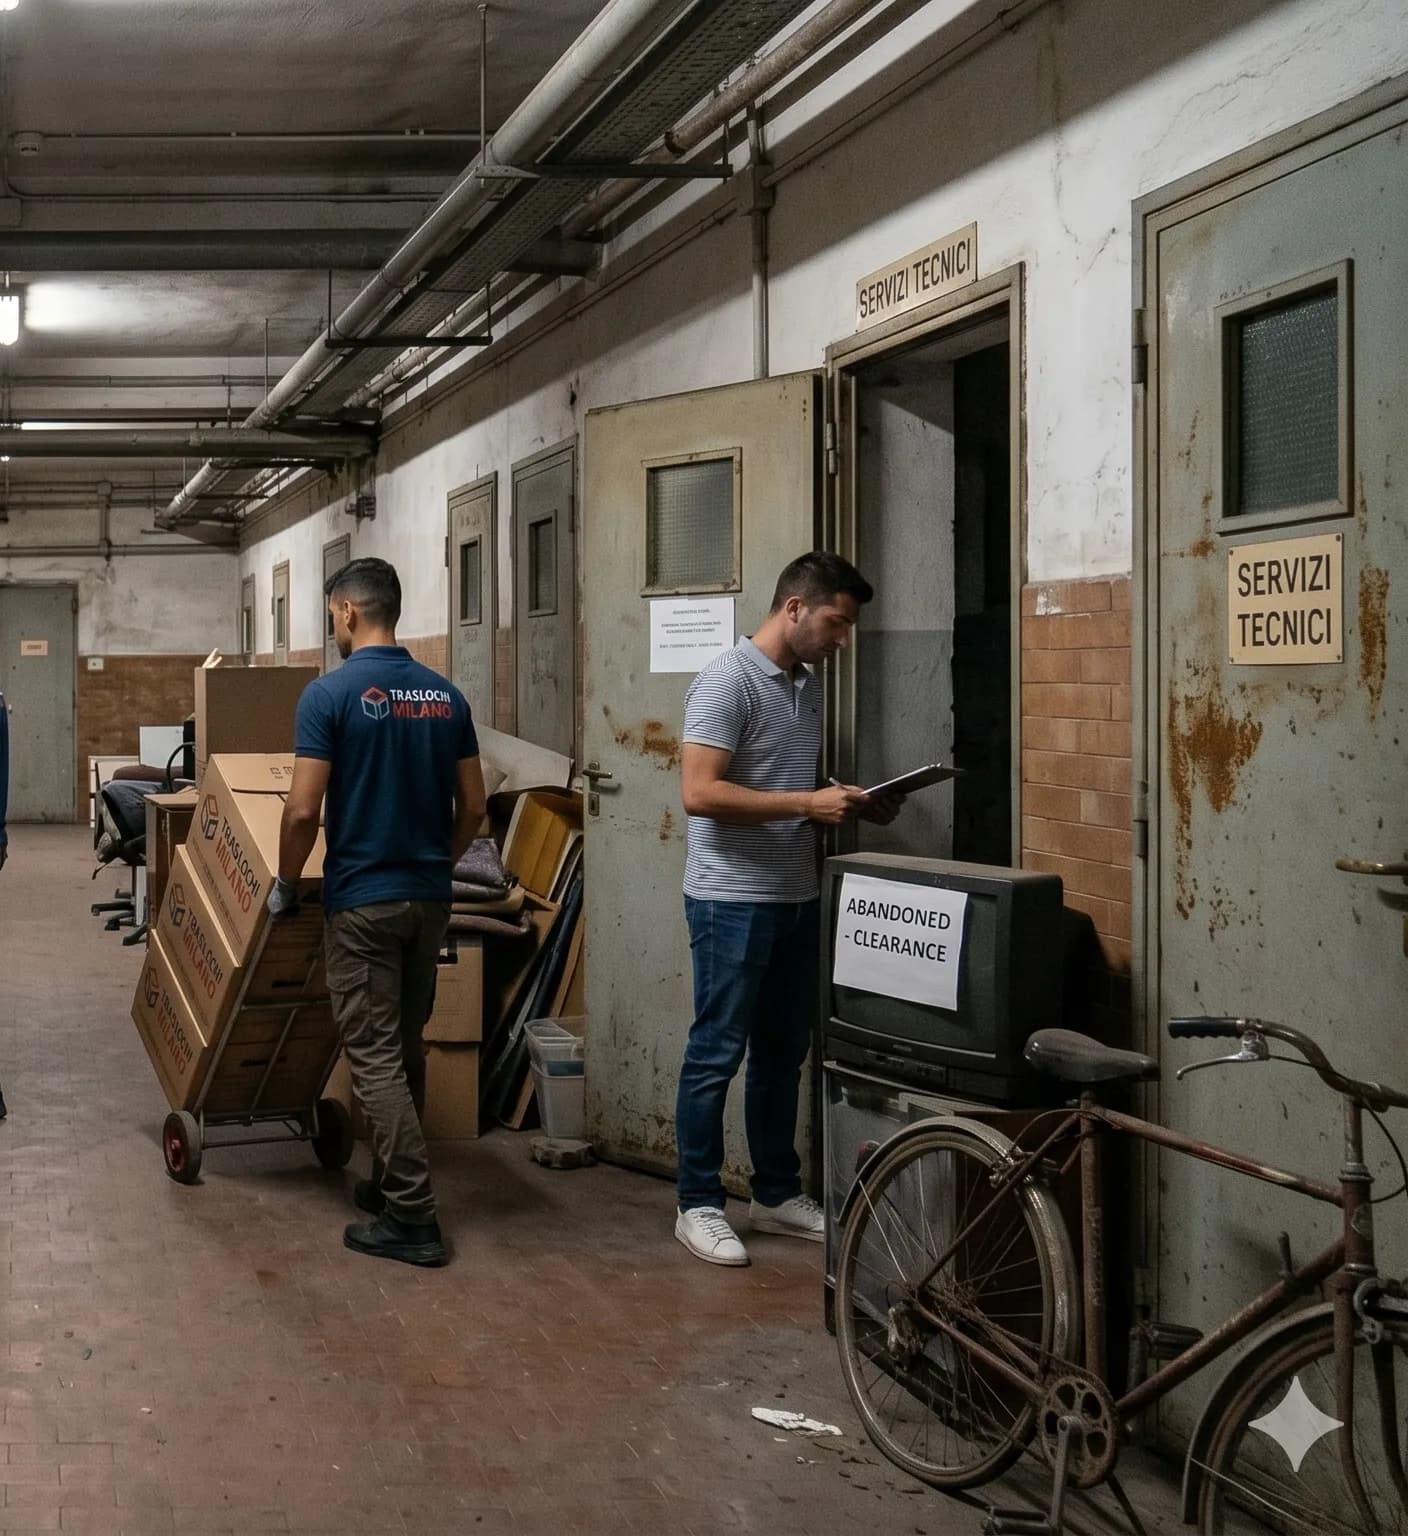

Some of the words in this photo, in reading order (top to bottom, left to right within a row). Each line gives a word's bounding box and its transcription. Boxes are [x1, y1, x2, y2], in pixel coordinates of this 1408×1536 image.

[859, 267, 909, 319] SERVIZI
[913, 237, 970, 294] TECNICI
[1238, 554, 1331, 597] SERVIZI
[1237, 608, 1331, 647] TECNICI
[392, 702, 452, 720] MILANO
[215, 837, 252, 913] MILANO
[846, 897, 951, 930] ABANDONED
[853, 929, 947, 962] CLEARANCE
